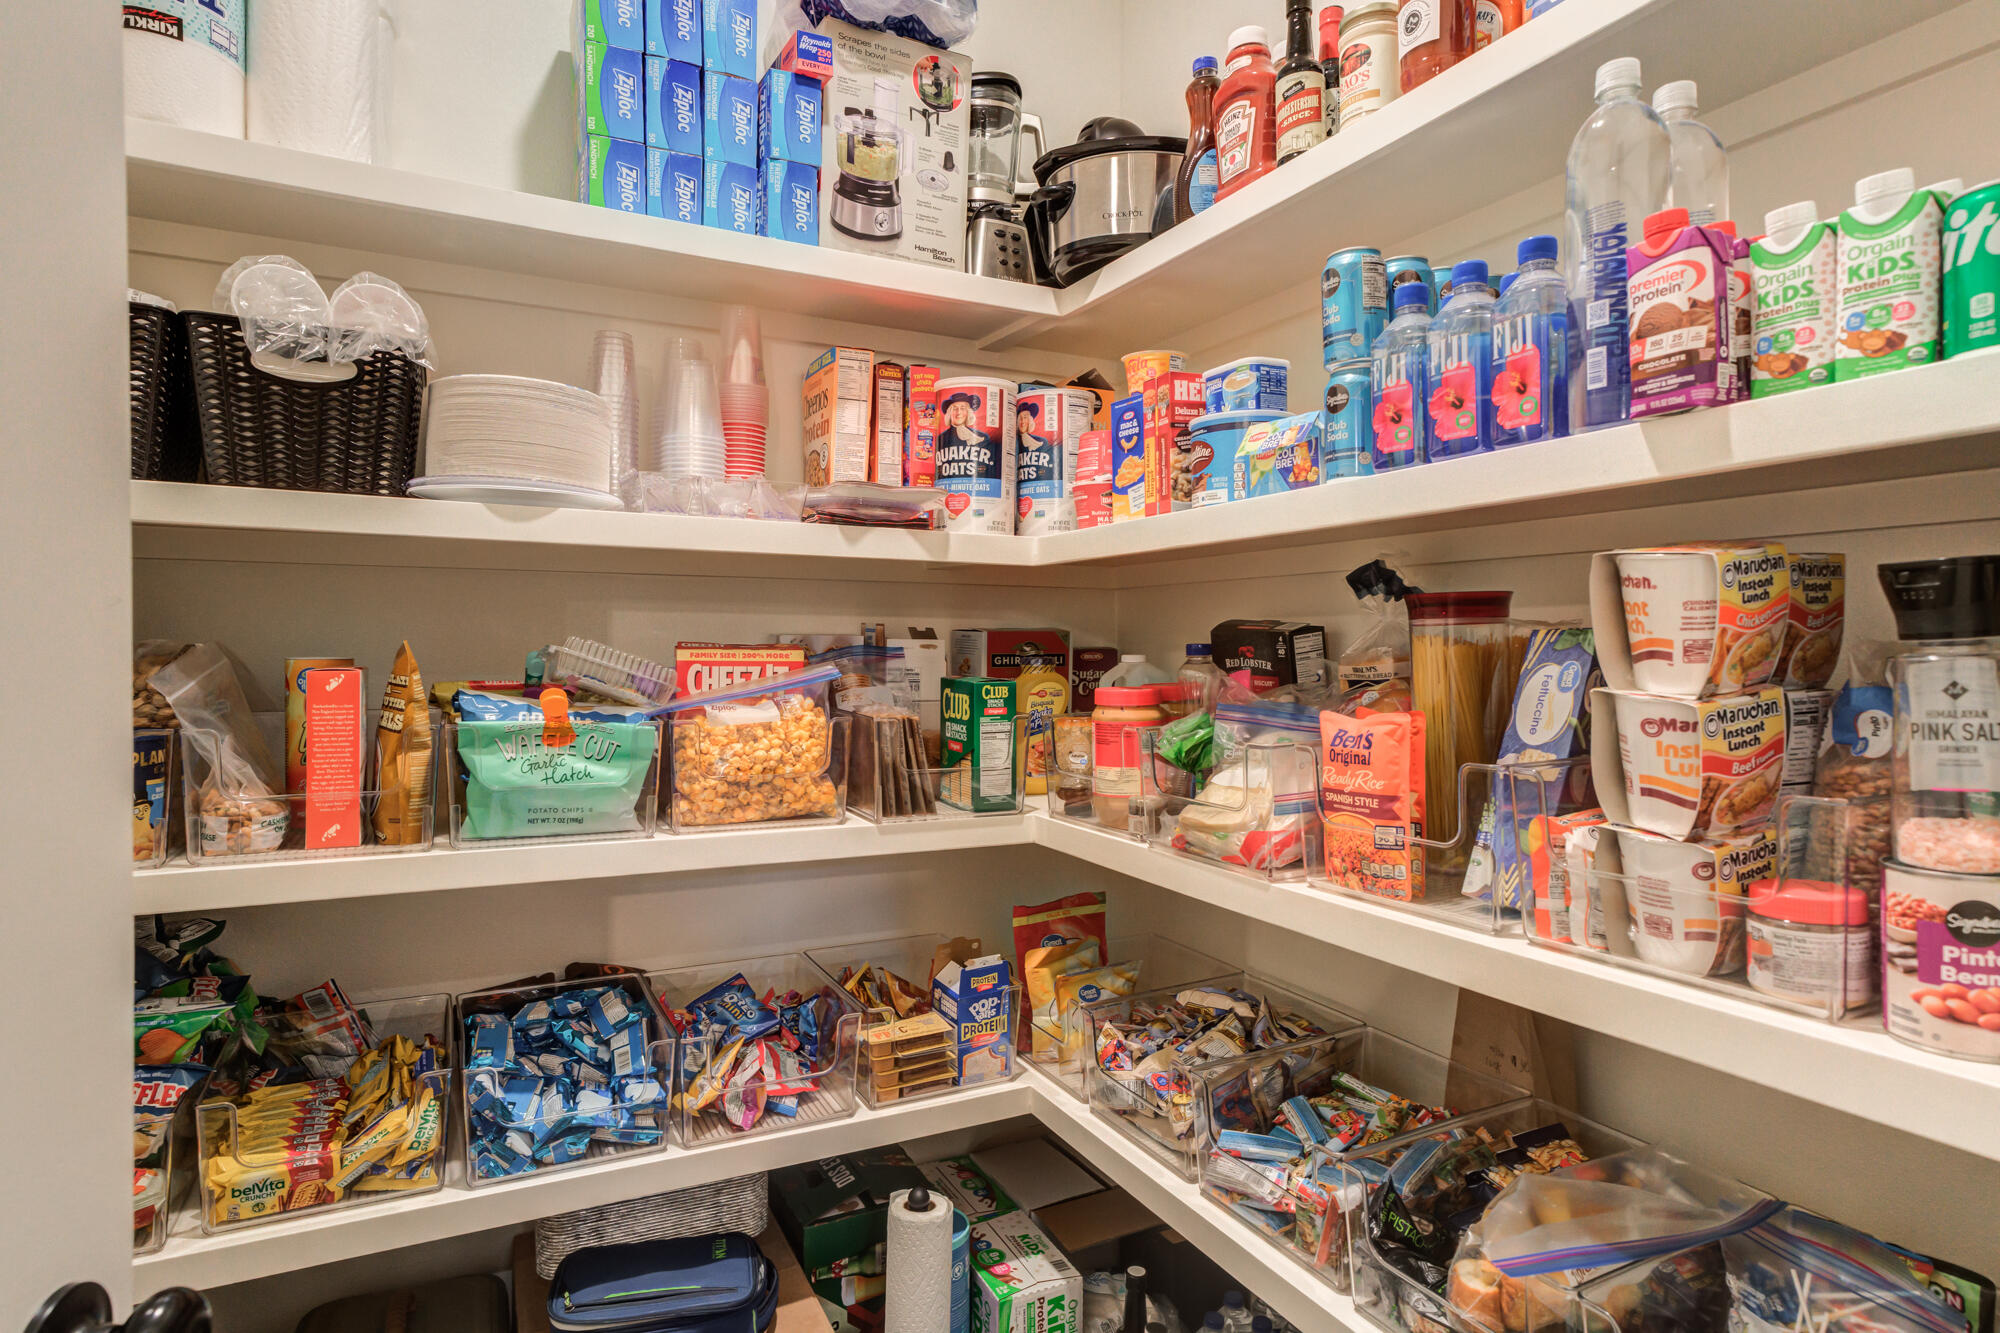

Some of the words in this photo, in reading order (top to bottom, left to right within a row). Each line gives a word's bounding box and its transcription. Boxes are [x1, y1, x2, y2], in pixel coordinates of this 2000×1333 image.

[731, 14, 751, 57] Ziploc
[801, 35, 832, 49] Reynolds
[799, 42, 818, 54] Wrap
[817, 48, 832, 58] 250
[838, 32, 872, 48] Scrapes
[874, 43, 887, 52] the
[889, 48, 911, 59] sides
[849, 45, 863, 55] the
[865, 49, 886, 61] bowl
[586, 45, 594, 86] SANDWICH
[613, 74, 634, 119] Ziploc
[673, 88, 695, 133] Ziploc
[1224, 111, 1242, 127] HEINZ
[1282, 110, 1311, 127] SAUCE
[732, 103, 751, 146] Ziploc
[795, 99, 815, 144] Ziploc
[590, 139, 598, 179] SANDWICH
[616, 166, 637, 212] Ziploc
[675, 177, 696, 221] Ziploc
[731, 188, 751, 231] Ziploc
[792, 189, 811, 232] Ziploc
[914, 244, 947, 256] Hamilton
[1847, 234, 1915, 261] Orgain
[932, 253, 956, 263] Beach
[1629, 267, 1687, 299] premier
[1757, 264, 1814, 289] Orgain
[1632, 282, 1683, 308] protein
[1843, 278, 1890, 296] protein
[1493, 312, 1534, 361] FIJI
[1430, 333, 1470, 377] FIJI
[1638, 354, 1687, 371] CHOCOLATE
[1373, 352, 1407, 393] FIJI
[1175, 407, 1198, 416] Deluxe
[1119, 427, 1140, 438] cheese
[1327, 421, 1347, 432] Club
[1327, 431, 1349, 442] Soda
[942, 462, 976, 476] OATS
[1275, 457, 1301, 470] BREW
[1018, 467, 1037, 480] ATS
[1733, 554, 1786, 575] Maruchan
[1799, 561, 1842, 577] Maruchan
[1738, 576, 1774, 592] Instant
[1802, 580, 1832, 593] Instant
[1742, 589, 1771, 605] Lunch
[1805, 593, 1830, 605] Lunch
[1736, 610, 1772, 626] Chicken
[742, 652, 764, 660] 200%
[1225, 658, 1239, 668] RED
[1239, 657, 1273, 670] LOBSTER
[1072, 669, 1106, 686] Sugar
[982, 685, 1009, 700] CLUB
[942, 689, 970, 721] CLUB
[1529, 674, 1553, 735] Fettuccine
[1717, 700, 1780, 723] Maruchan
[1926, 709, 1989, 719] HIMALAYAN
[950, 731, 967, 741] STACKS
[951, 722, 967, 733] SNACK
[1722, 721, 1765, 740] Instant
[1912, 723, 1954, 740] PINK
[1330, 728, 1373, 750] Ben's
[1728, 736, 1761, 753] Lunch
[495, 734, 577, 761] WAFFLE
[584, 734, 622, 764] CUT
[1329, 749, 1371, 767] Original
[520, 753, 567, 774] Garlic
[1732, 757, 1756, 775] Beef
[540, 766, 594, 785] Hatch
[1323, 766, 1355, 793] Ready
[1356, 770, 1385, 790] Rice
[1325, 792, 1353, 804] SPANISH
[1354, 796, 1379, 808] STYLE
[1736, 861, 1772, 883] Instant
[972, 975, 997, 985] PROTEIN
[1080, 988, 1097, 996] Great
[719, 1002, 745, 1020] mini
[725, 992, 756, 1021] OREO
[963, 1017, 1006, 1036] PROTEIN
[407, 1097, 437, 1152] belVita
[828, 1164, 855, 1189] DOS
[231, 1177, 286, 1200] belVita
[240, 1190, 278, 1205] CRUNCHY
